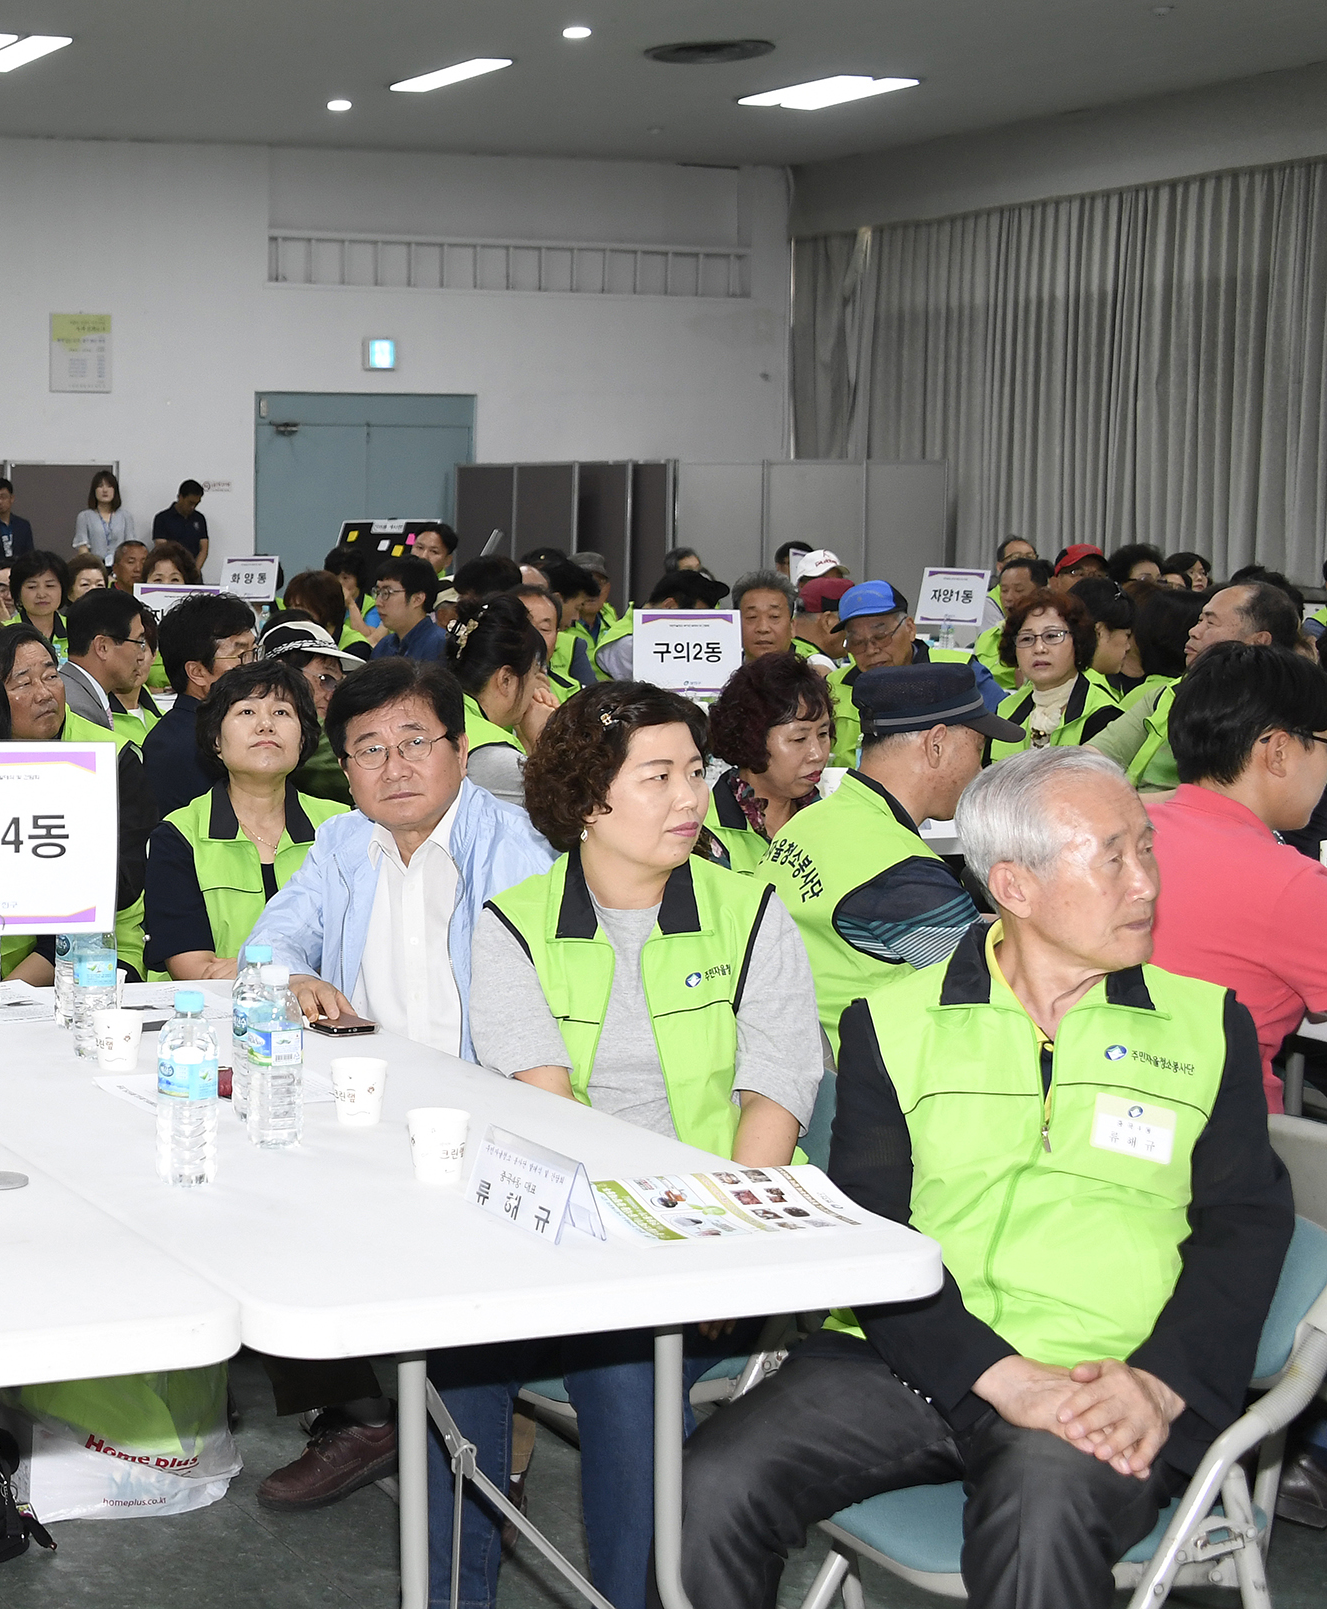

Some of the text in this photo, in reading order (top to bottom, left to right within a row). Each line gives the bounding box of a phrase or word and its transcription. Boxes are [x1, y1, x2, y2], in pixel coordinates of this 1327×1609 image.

[930, 588, 974, 605] 자양1동
[653, 642, 723, 663] 구의2동
[1131, 1049, 1195, 1076] 주민자율청소봉사단
[524, 1180, 537, 1195] 대표
[85, 1433, 200, 1469] Home plus
